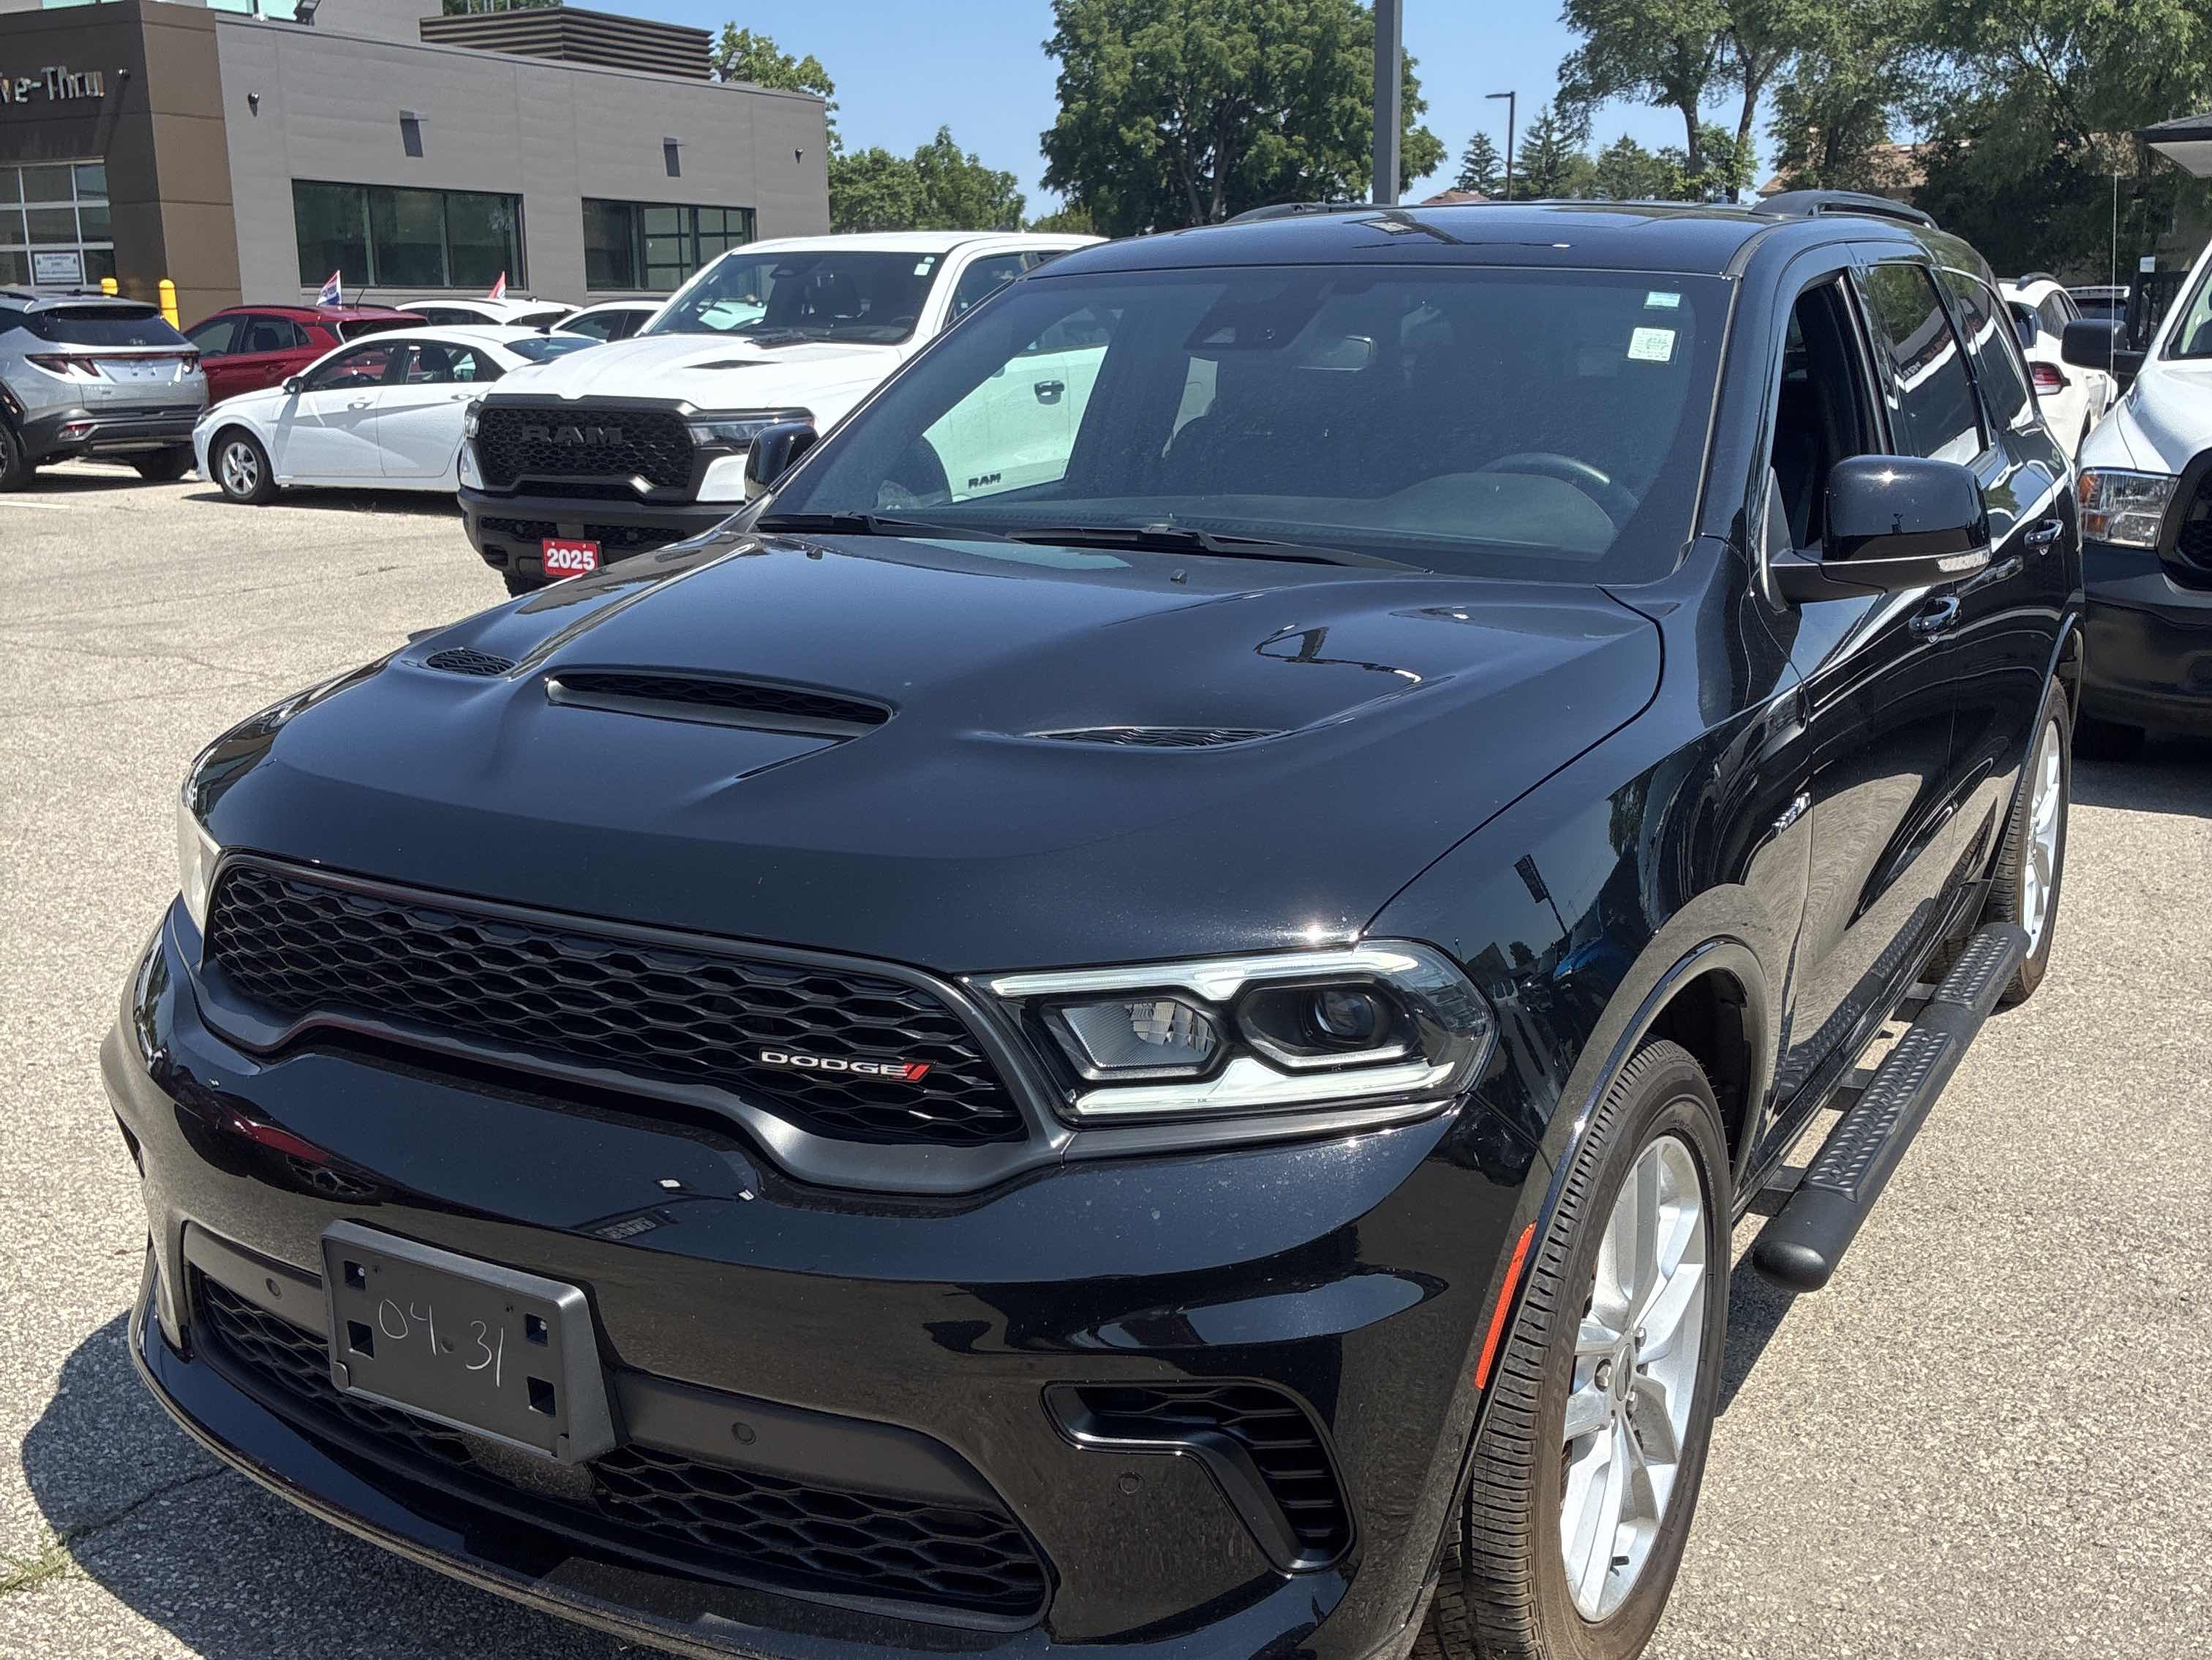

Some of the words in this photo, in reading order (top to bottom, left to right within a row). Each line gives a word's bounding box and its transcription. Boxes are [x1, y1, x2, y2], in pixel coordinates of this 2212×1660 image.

[522, 427, 622, 445] RAM
[968, 473, 1001, 489] RAM
[546, 548, 595, 571] 2025
[761, 1051, 908, 1077] DODGE
[379, 1299, 437, 1356] 04
[465, 1320, 505, 1387] 31
